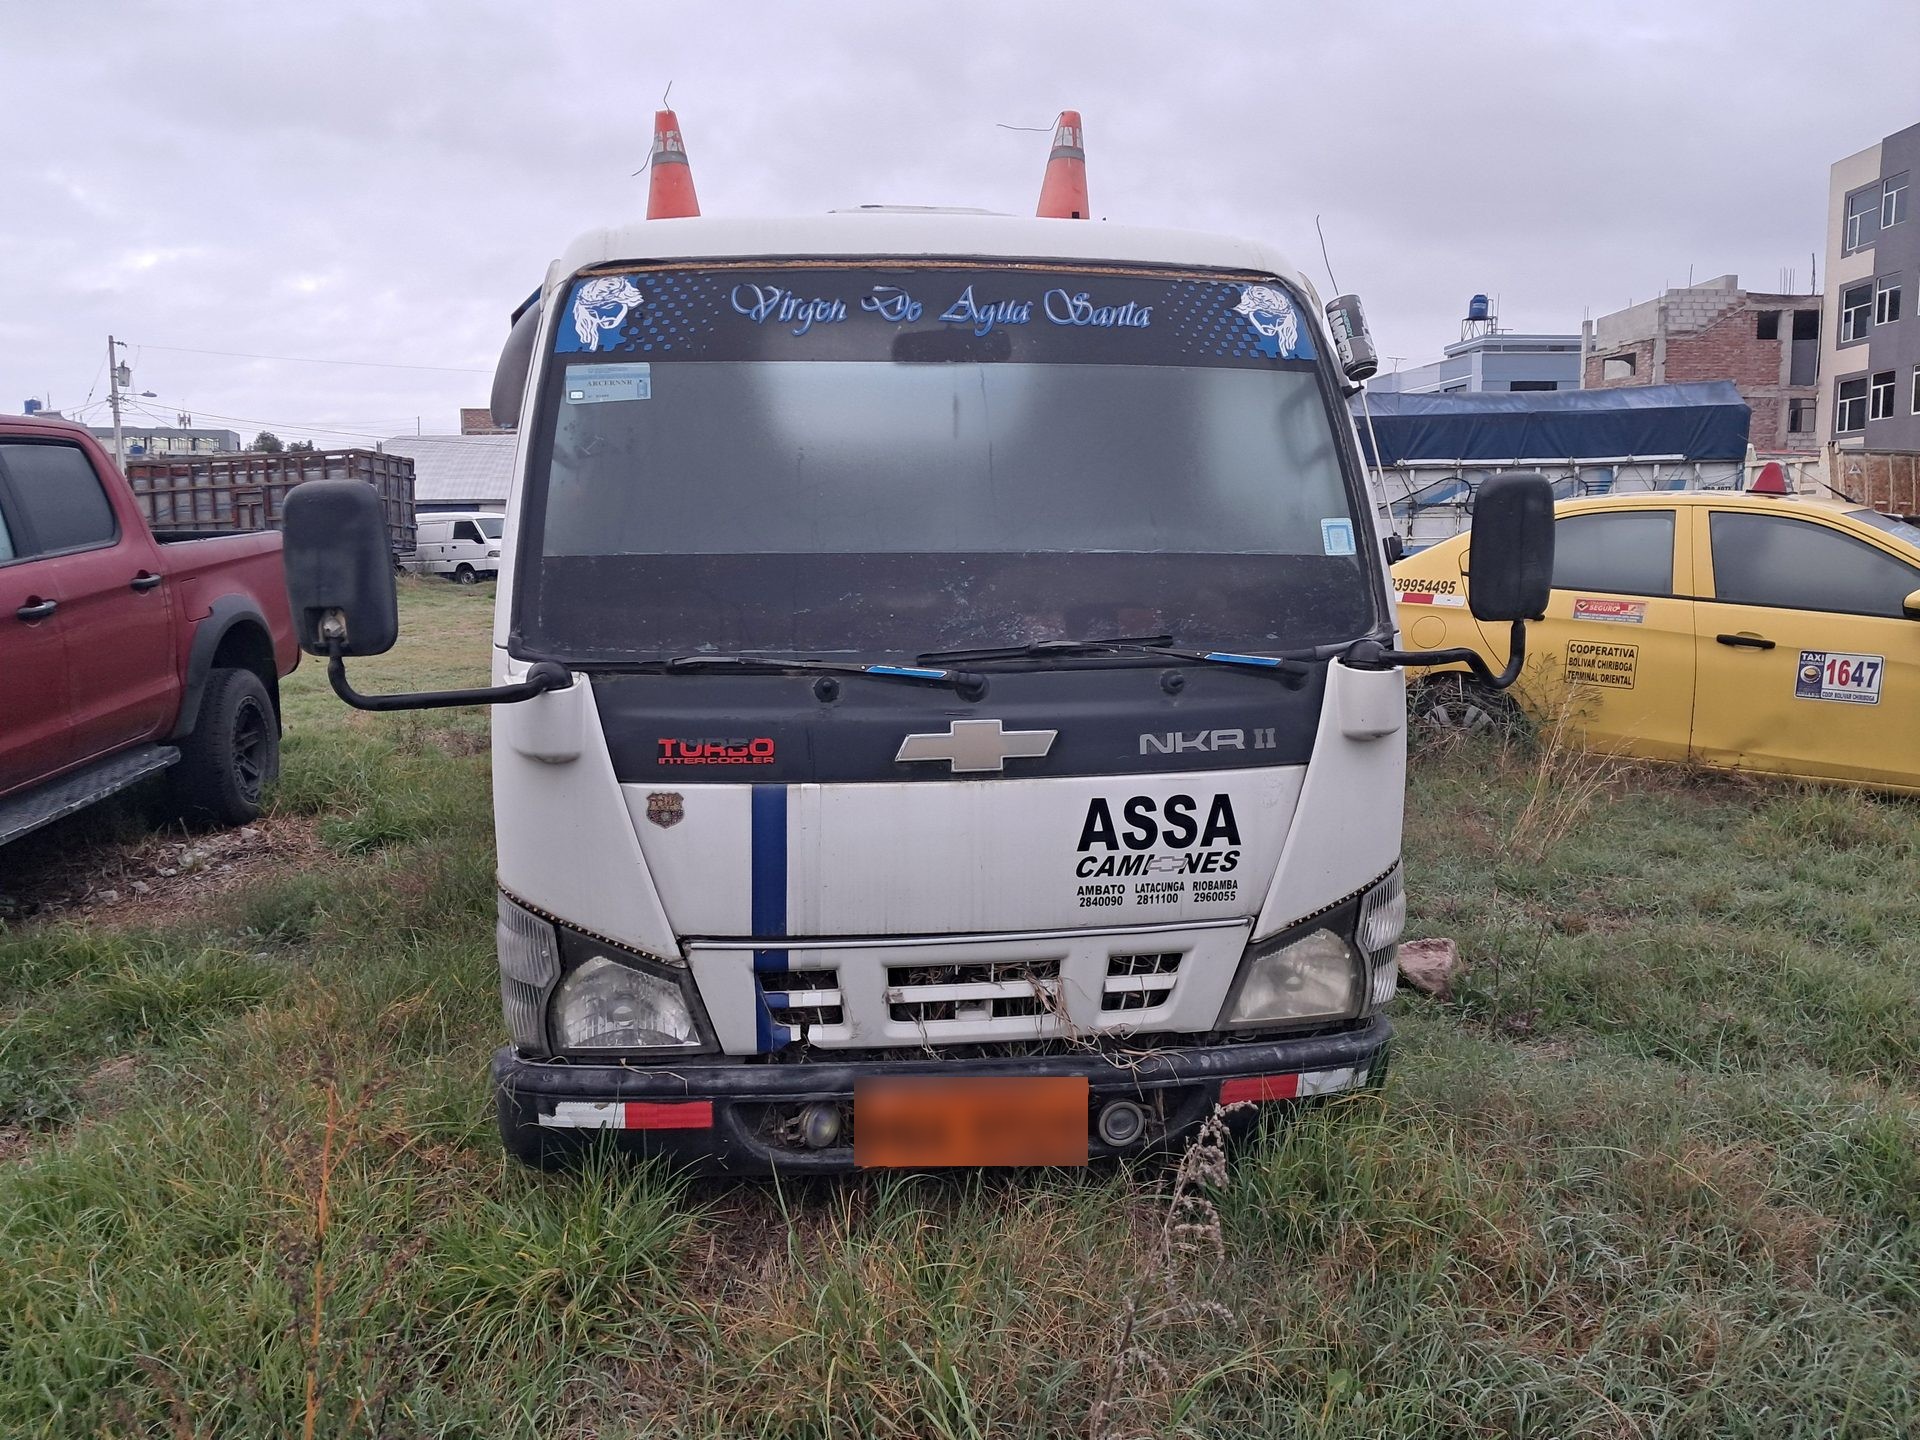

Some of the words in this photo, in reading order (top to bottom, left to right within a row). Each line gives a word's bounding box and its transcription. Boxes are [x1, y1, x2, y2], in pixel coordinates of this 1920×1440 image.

[731, 283, 848, 336] Virgen
[860, 285, 923, 322] De
[938, 284, 1034, 337] Agua
[1043, 288, 1153, 329] Santa
[1569, 643, 1635, 659] COOPERATIVA
[1801, 652, 1825, 662] TAXI
[1568, 657, 1596, 669] BOLIVAR
[1597, 659, 1633, 672] CHIRIBOGA
[1826, 658, 1880, 688] 1647
[1567, 670, 1599, 682] TERMINAL
[1600, 673, 1632, 686] ORIENTAL
[657, 737, 775, 757] TURBO
[1139, 728, 1246, 755] NKR
[1253, 727, 1277, 749] II
[657, 757, 775, 765] INTERCOOLER
[1076, 793, 1242, 851] ASSA
[1075, 850, 1241, 878] CAMINES
[1076, 884, 1125, 897] AMBATO
[1135, 881, 1185, 894] LATACUNGA
[1192, 879, 1238, 892] RIOBAMBA
[1079, 896, 1124, 907] 2840090
[1137, 893, 1179, 905] 2811100
[1194, 891, 1236, 902] 2960055
